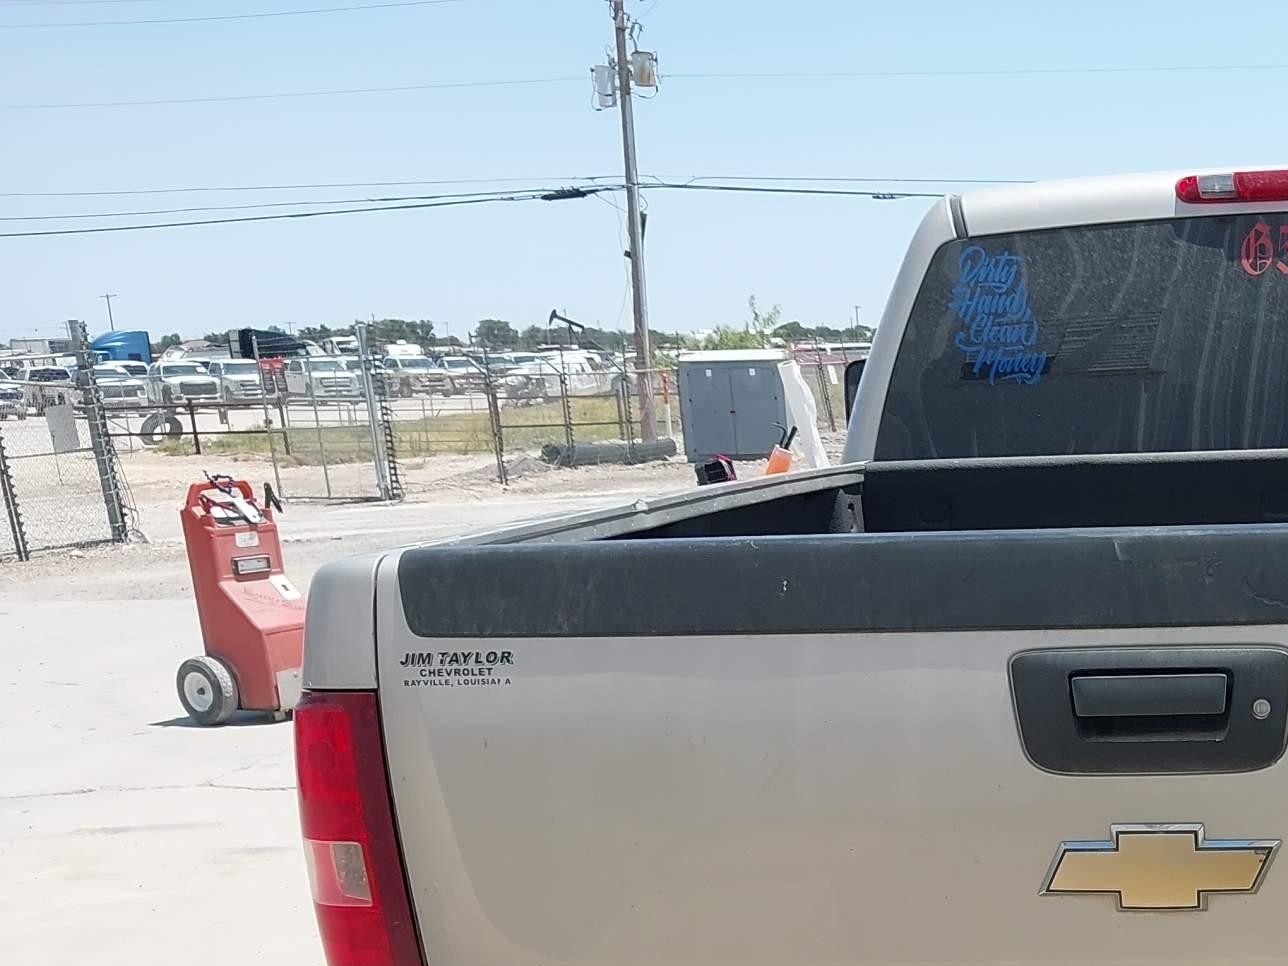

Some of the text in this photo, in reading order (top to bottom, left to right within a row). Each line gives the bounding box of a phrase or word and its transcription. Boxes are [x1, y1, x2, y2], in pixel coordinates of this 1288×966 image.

[959, 246, 1022, 292] Dirty
[972, 347, 1047, 385] Money
[400, 651, 514, 667] JIM TAYLOR
[419, 667, 494, 678] CHEVROLET
[404, 679, 454, 687] RAYVILLE,
